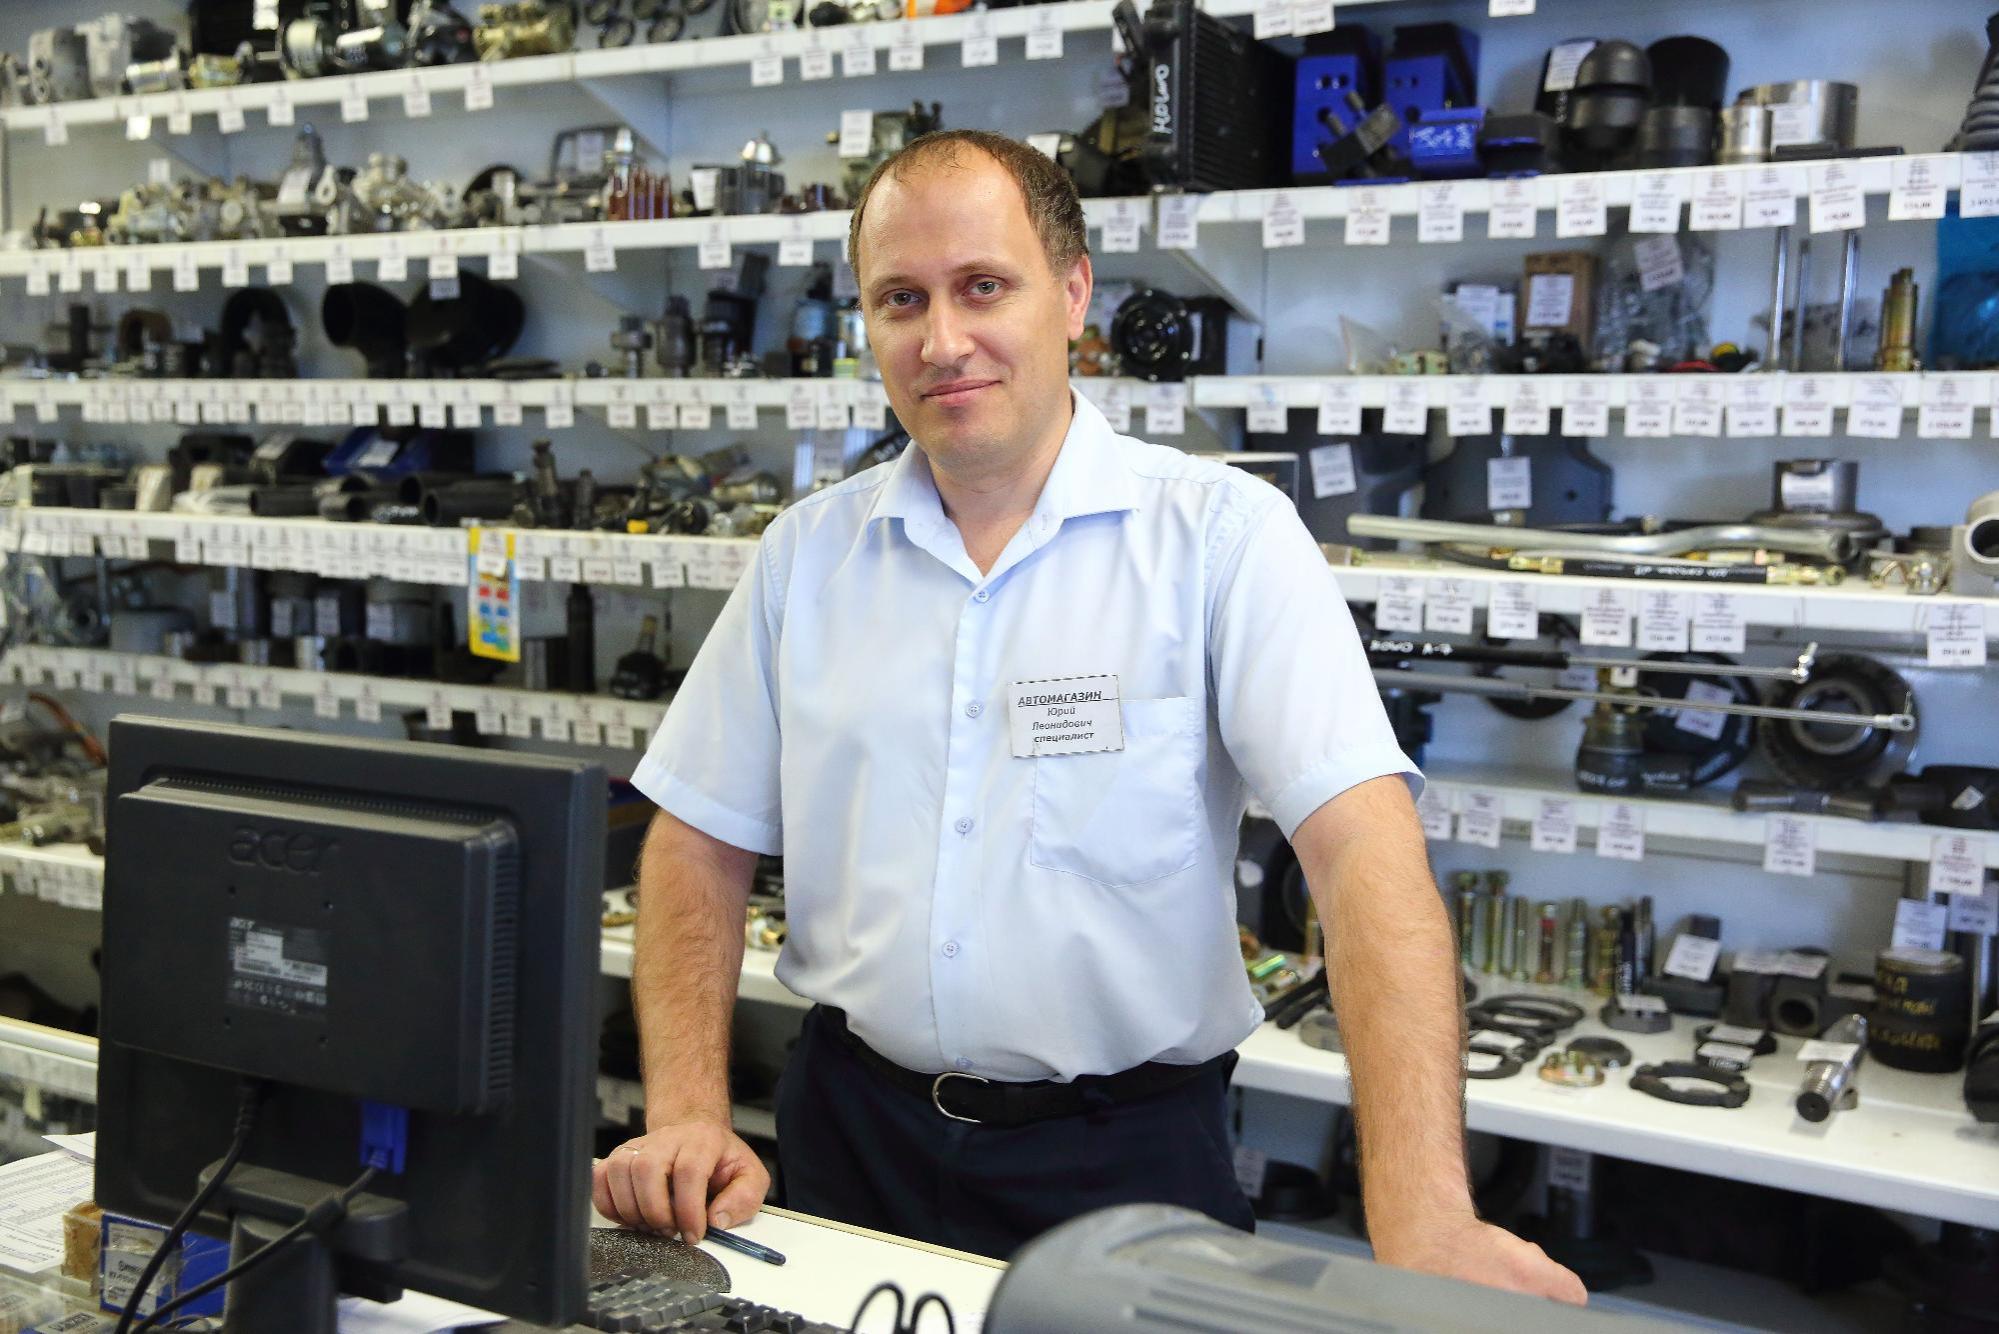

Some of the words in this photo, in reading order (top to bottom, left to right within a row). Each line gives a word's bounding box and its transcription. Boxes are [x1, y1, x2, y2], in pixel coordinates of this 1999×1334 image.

[1018, 690, 1102, 706] АВТОМАГАЗИН
[1047, 706, 1076, 717] Юрий
[1032, 720, 1093, 731] Леонидович
[1033, 732, 1095, 743] специалист
[227, 824, 341, 878] acer
